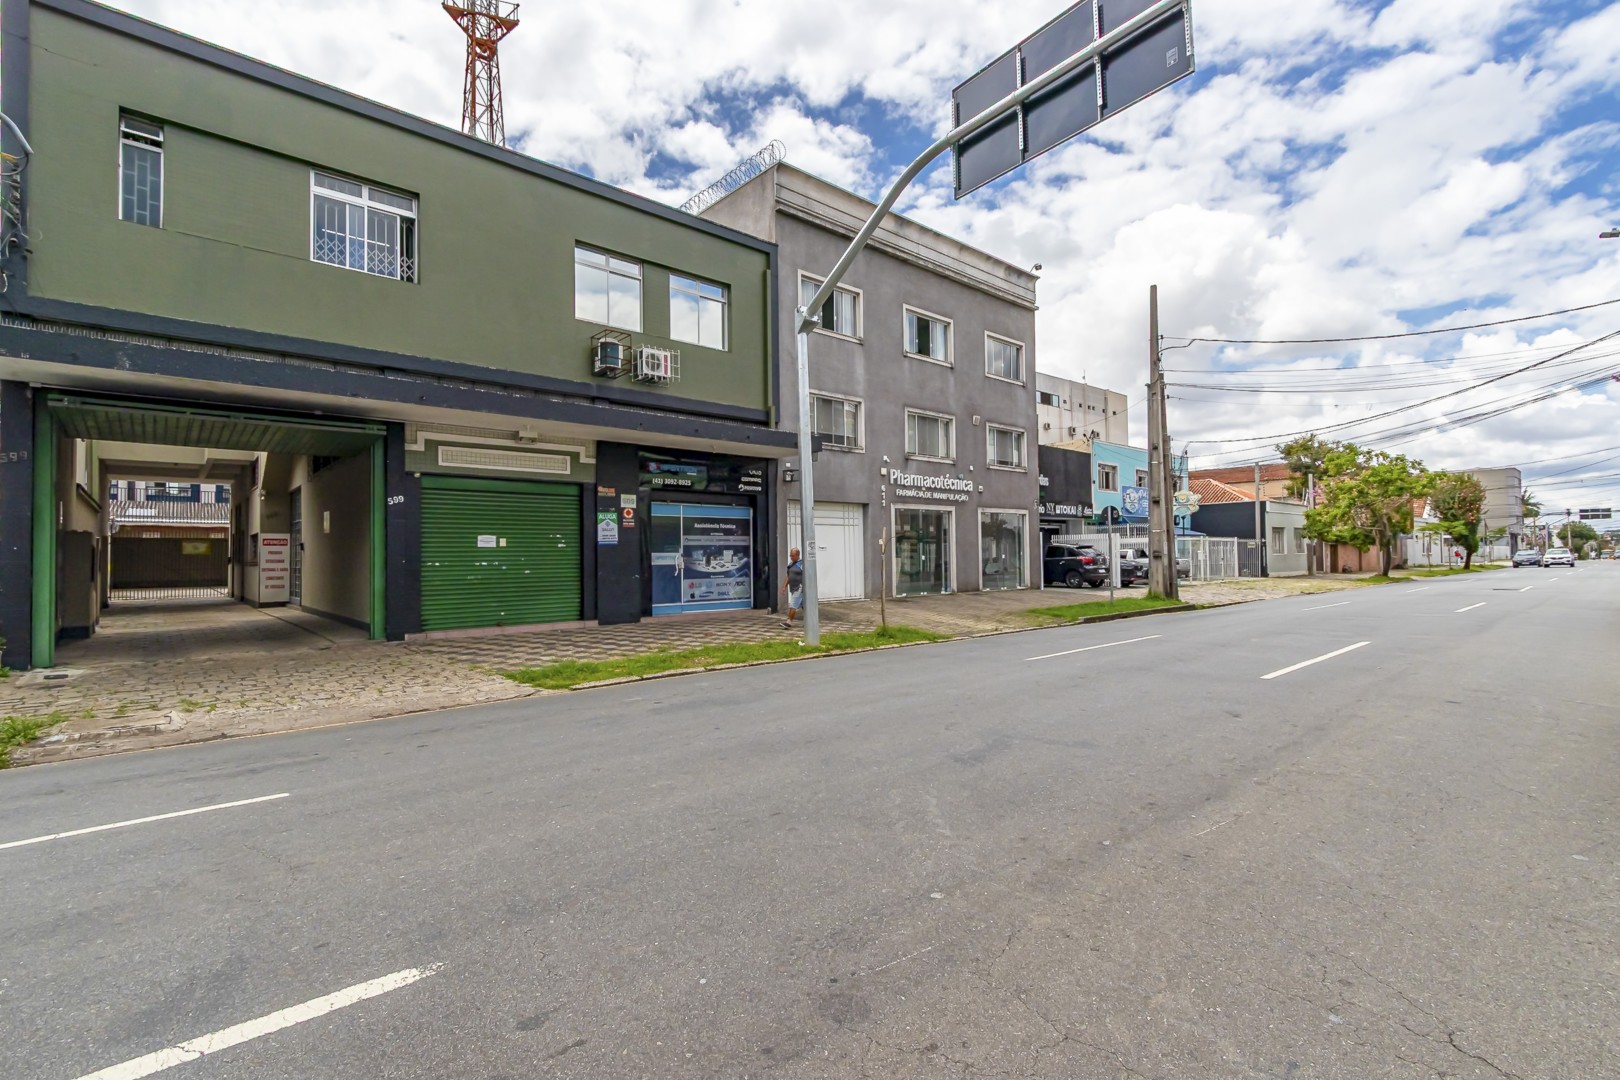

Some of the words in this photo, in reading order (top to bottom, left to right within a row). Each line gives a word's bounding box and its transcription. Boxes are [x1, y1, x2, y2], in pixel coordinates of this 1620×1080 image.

[889, 468, 974, 492] Pharmacotécnica
[387, 495, 404, 505] 599
[896, 488, 925, 498] FARMÁCIA
[925, 491, 932, 499] DE
[933, 492, 969, 502] MANIPULAÇÃO
[1060, 505, 1077, 515] TOKAI
